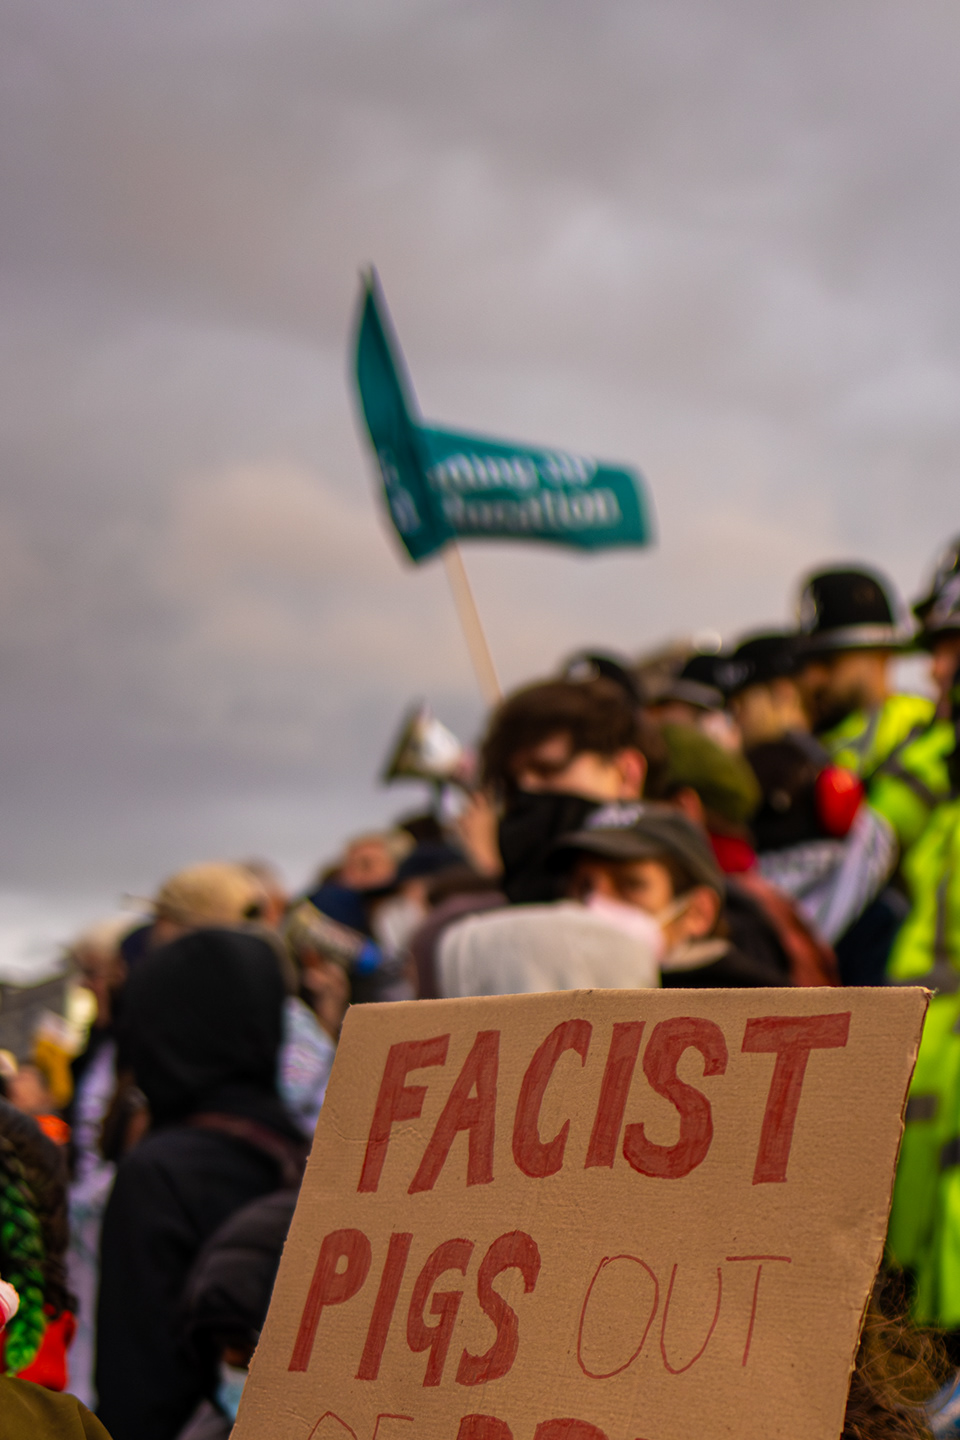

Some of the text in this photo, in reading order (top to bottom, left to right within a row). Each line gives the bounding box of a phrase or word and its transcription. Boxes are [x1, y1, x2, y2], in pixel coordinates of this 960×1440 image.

[356, 1011, 852, 1195] FACIST
[287, 1227, 792, 1388] PIGS OUT
